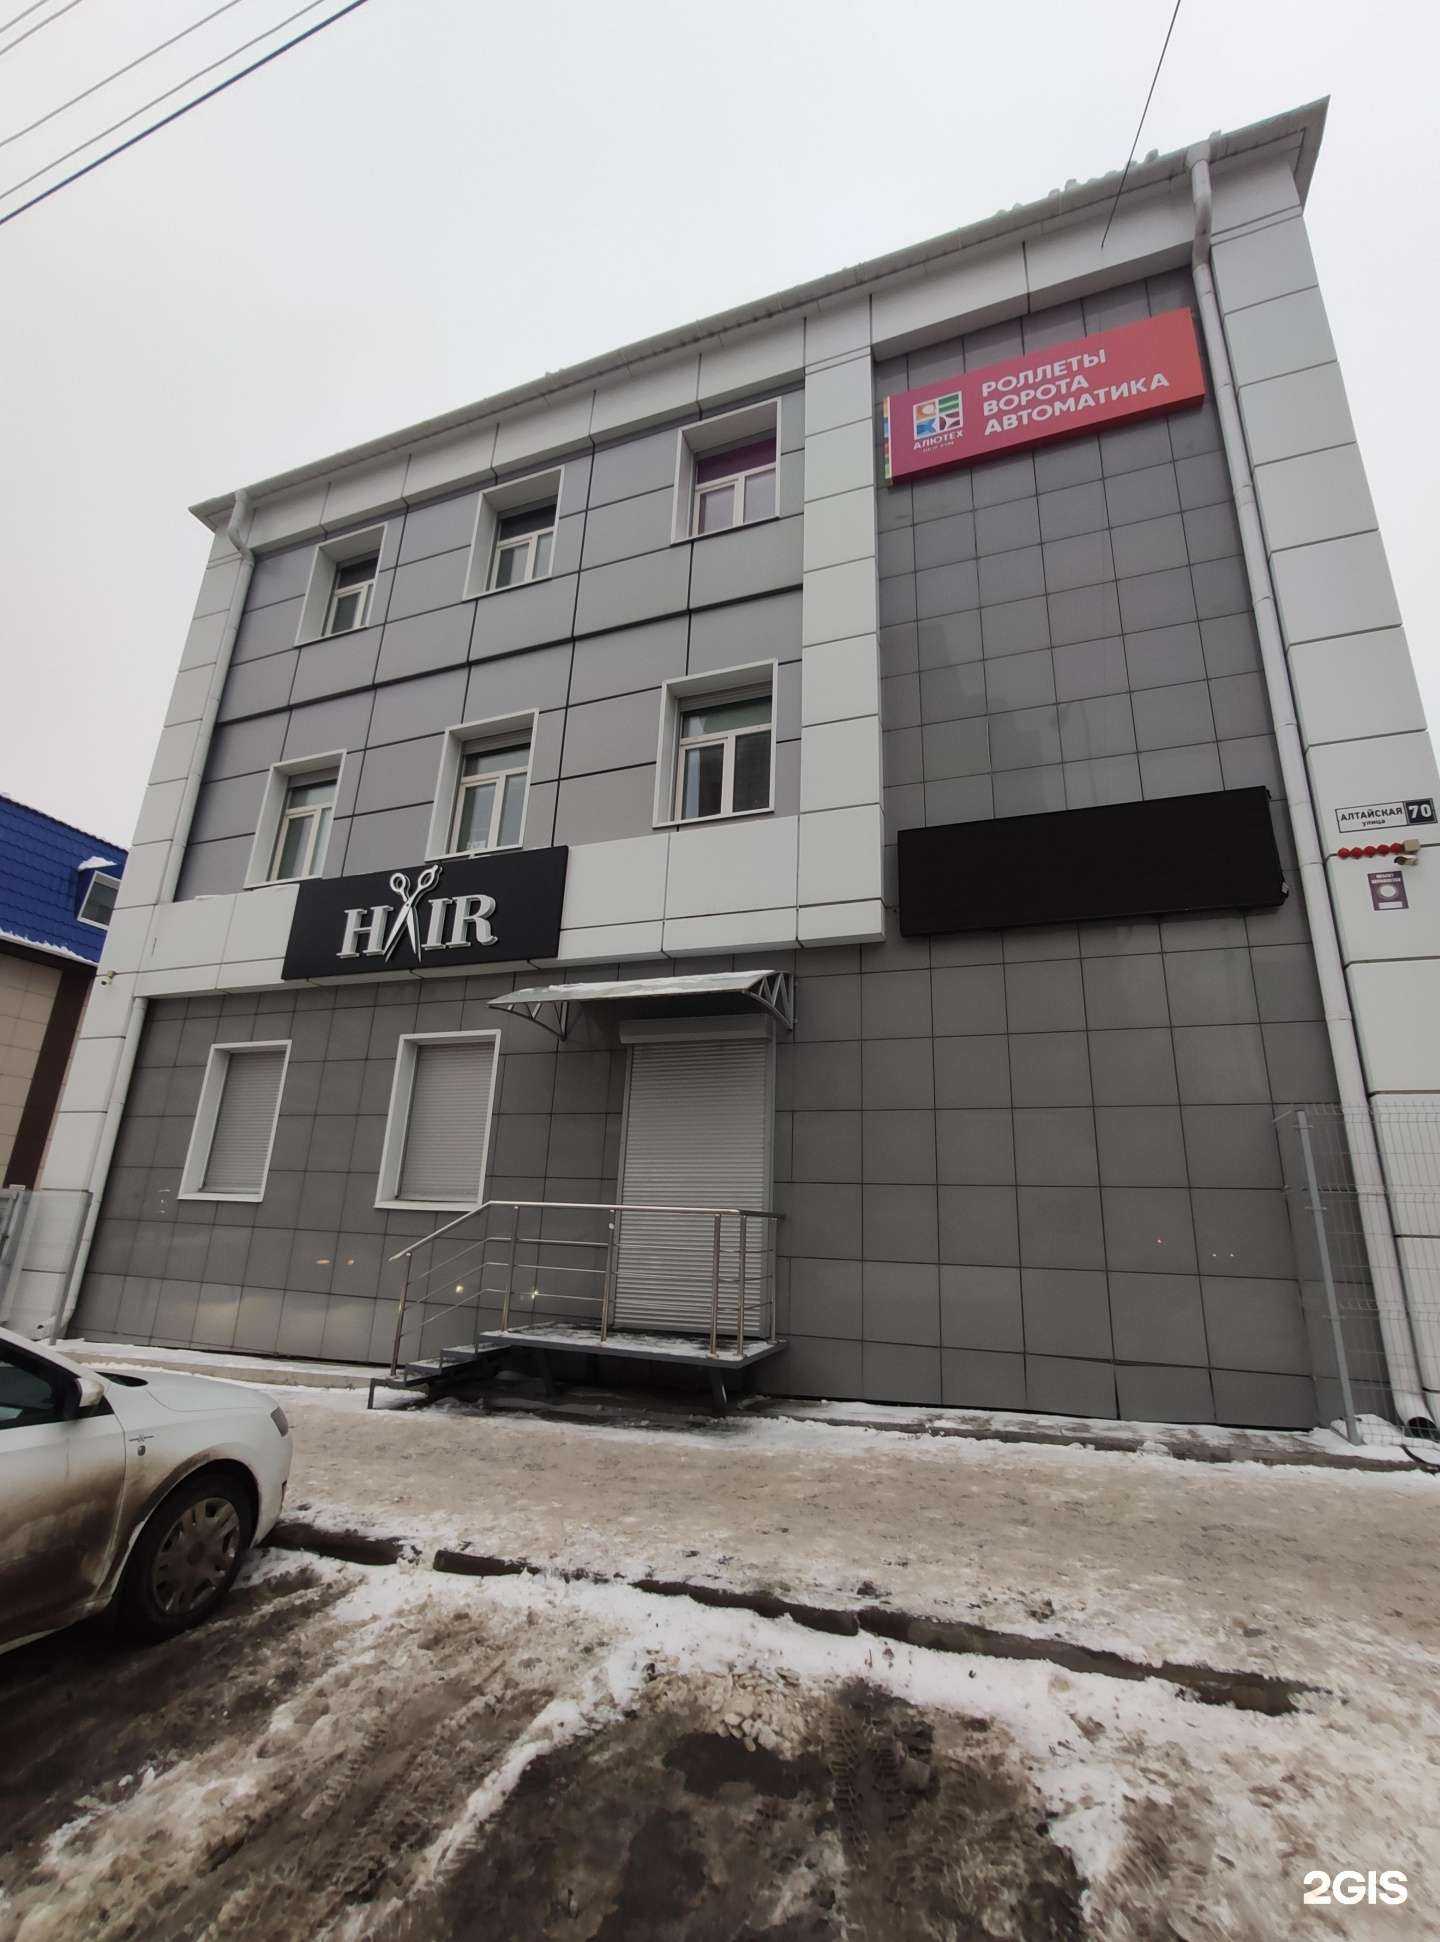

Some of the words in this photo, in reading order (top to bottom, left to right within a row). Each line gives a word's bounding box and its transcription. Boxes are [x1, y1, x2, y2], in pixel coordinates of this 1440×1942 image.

[981, 349, 1107, 398] РОЛЛЕТЫ
[983, 378, 1090, 417] ВОРОТА
[984, 372, 1171, 436] АВТОМАТИКА
[1340, 807, 1403, 822] АЛТАЙСКАЯ
[1408, 804, 1432, 819] 70
